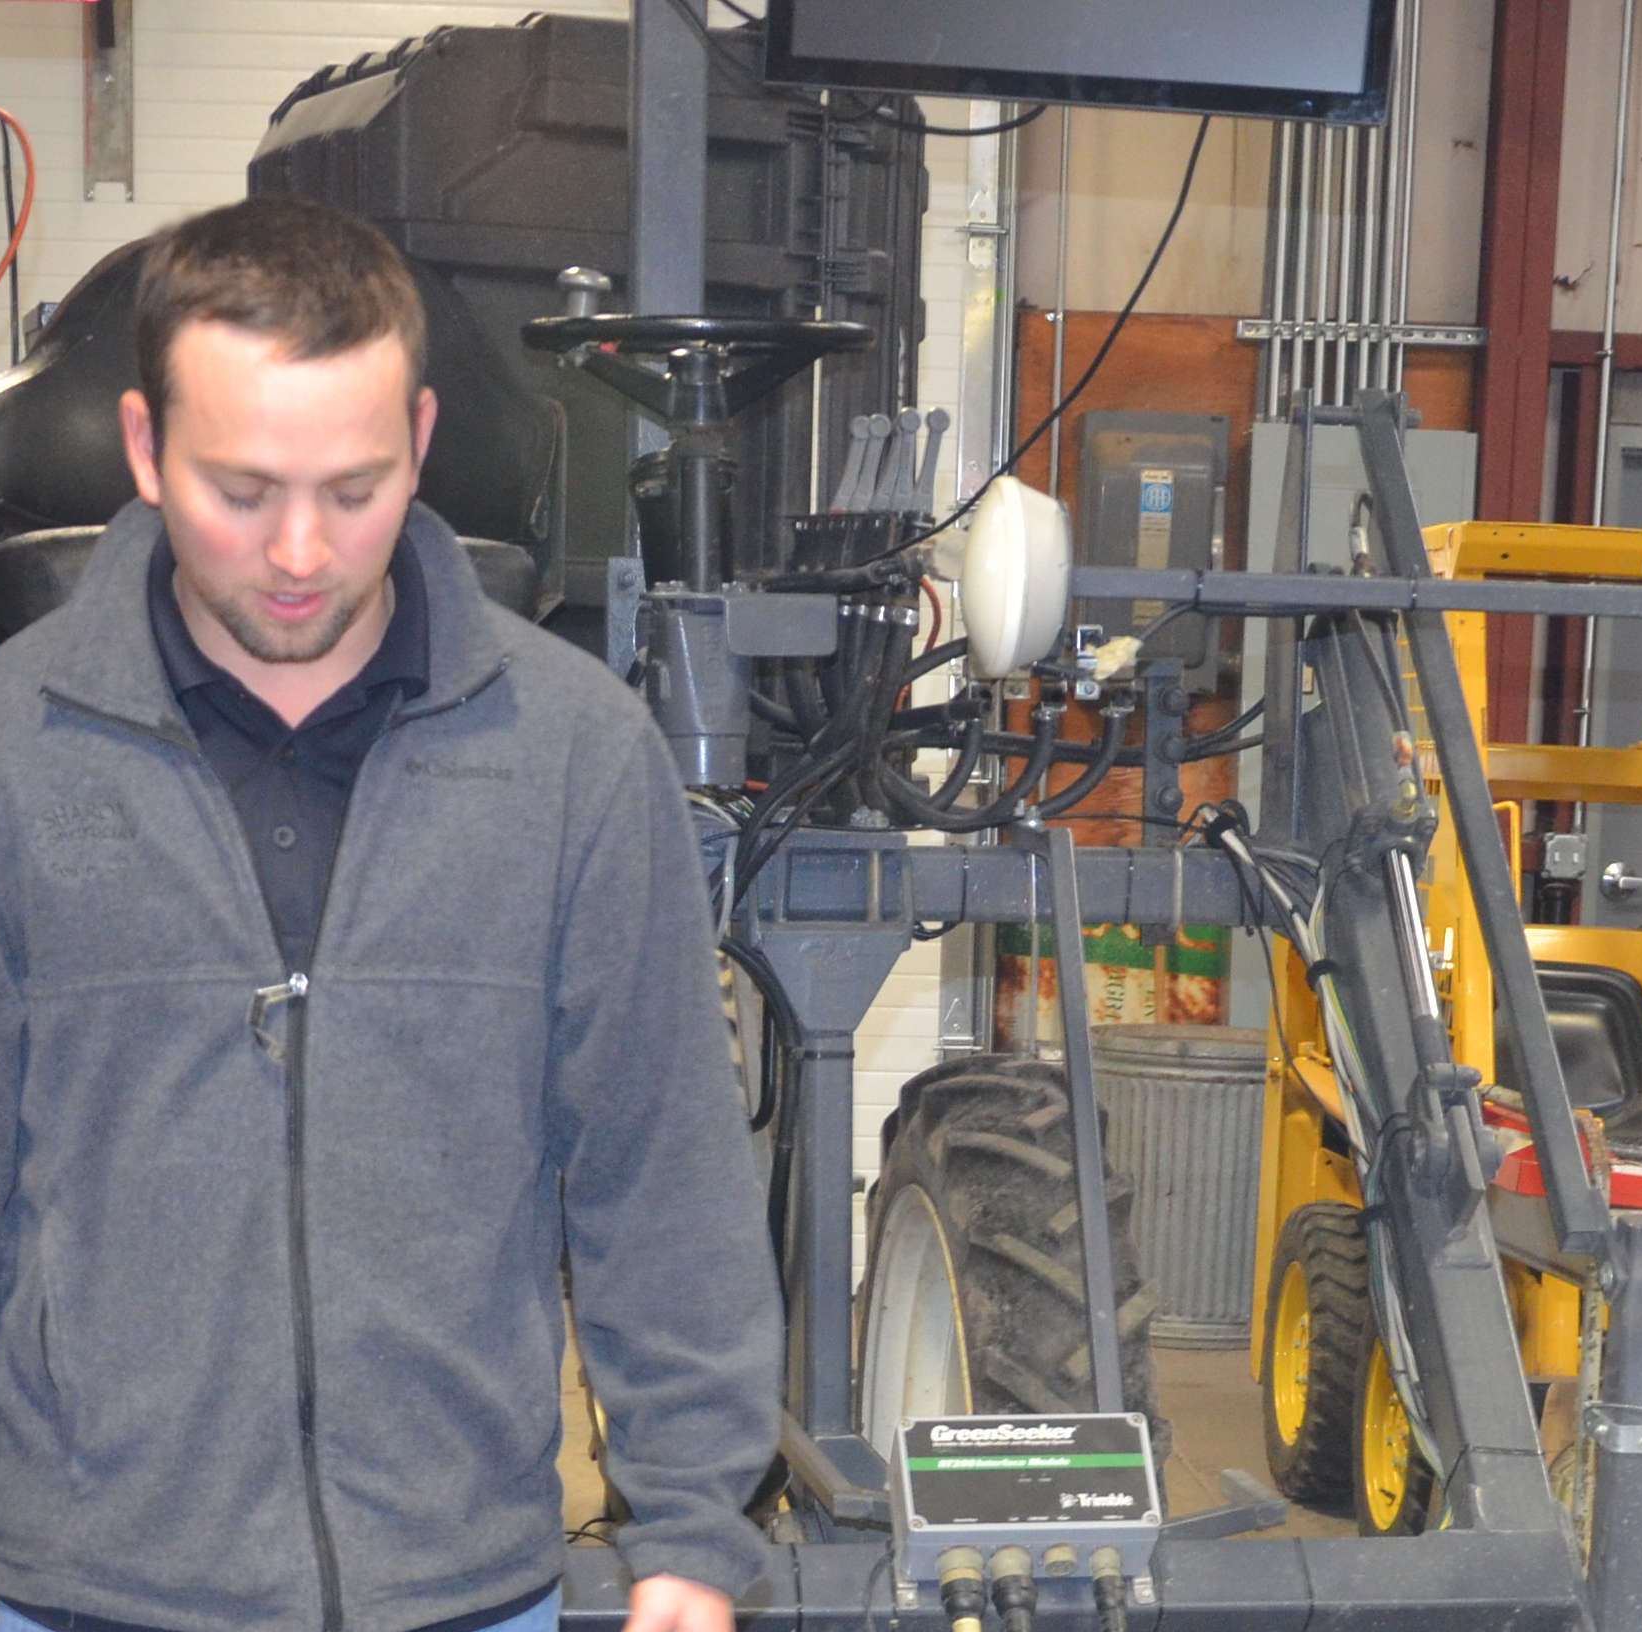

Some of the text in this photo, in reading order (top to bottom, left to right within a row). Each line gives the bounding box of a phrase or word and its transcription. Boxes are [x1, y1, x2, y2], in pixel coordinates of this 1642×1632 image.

[930, 1424, 1076, 1442] GreenSeeker
[976, 1459, 1026, 1467] Interface
[1028, 1457, 1071, 1466] Module
[1077, 1493, 1134, 1507] Trimble
